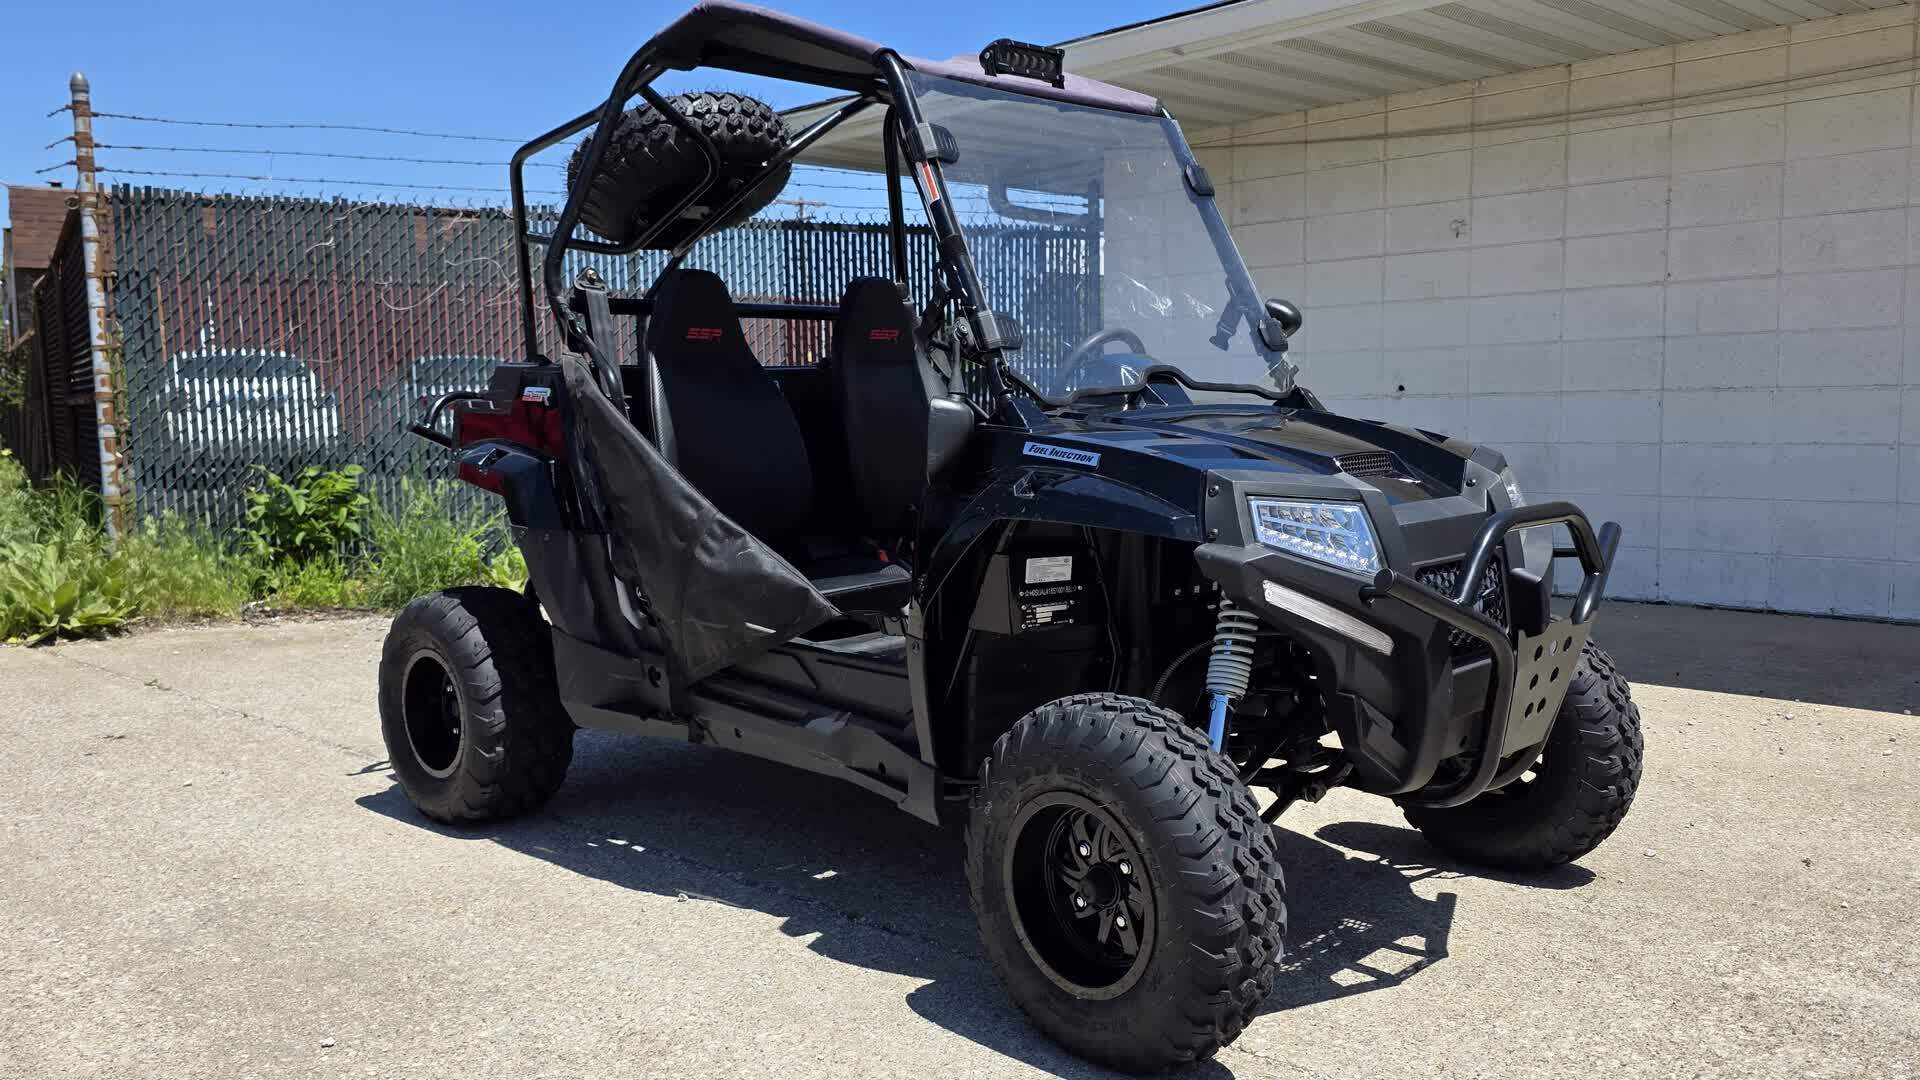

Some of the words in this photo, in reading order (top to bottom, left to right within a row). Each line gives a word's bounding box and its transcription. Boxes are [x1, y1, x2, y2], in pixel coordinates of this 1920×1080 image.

[686, 327, 722, 343] SSR
[870, 329, 899, 342] SSR
[1028, 444, 1049, 455] FUEL
[1049, 447, 1095, 463] INJECTION
